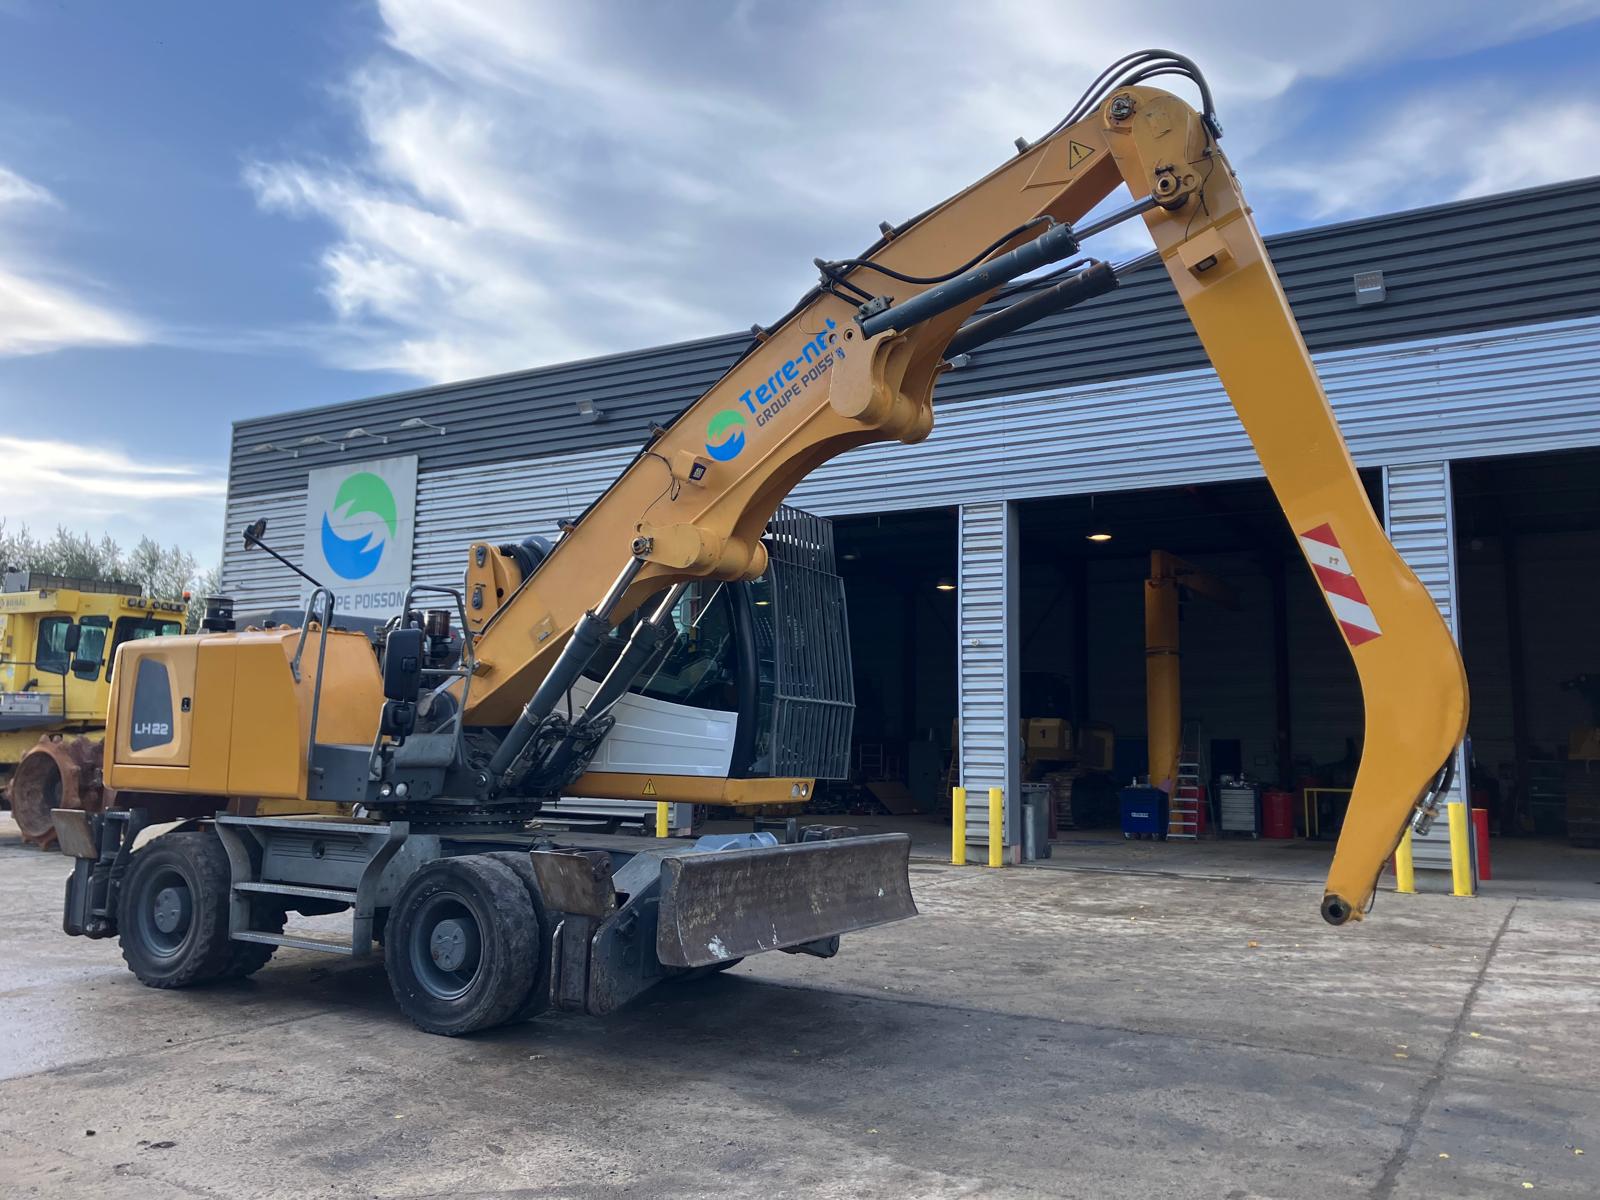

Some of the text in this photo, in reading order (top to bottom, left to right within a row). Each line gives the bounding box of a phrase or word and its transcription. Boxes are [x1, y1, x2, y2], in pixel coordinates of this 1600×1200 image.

[755, 346, 846, 428] GROUPE POISSN
[304, 591, 405, 611] ROPE POISSON
[134, 723, 169, 737] LH22
